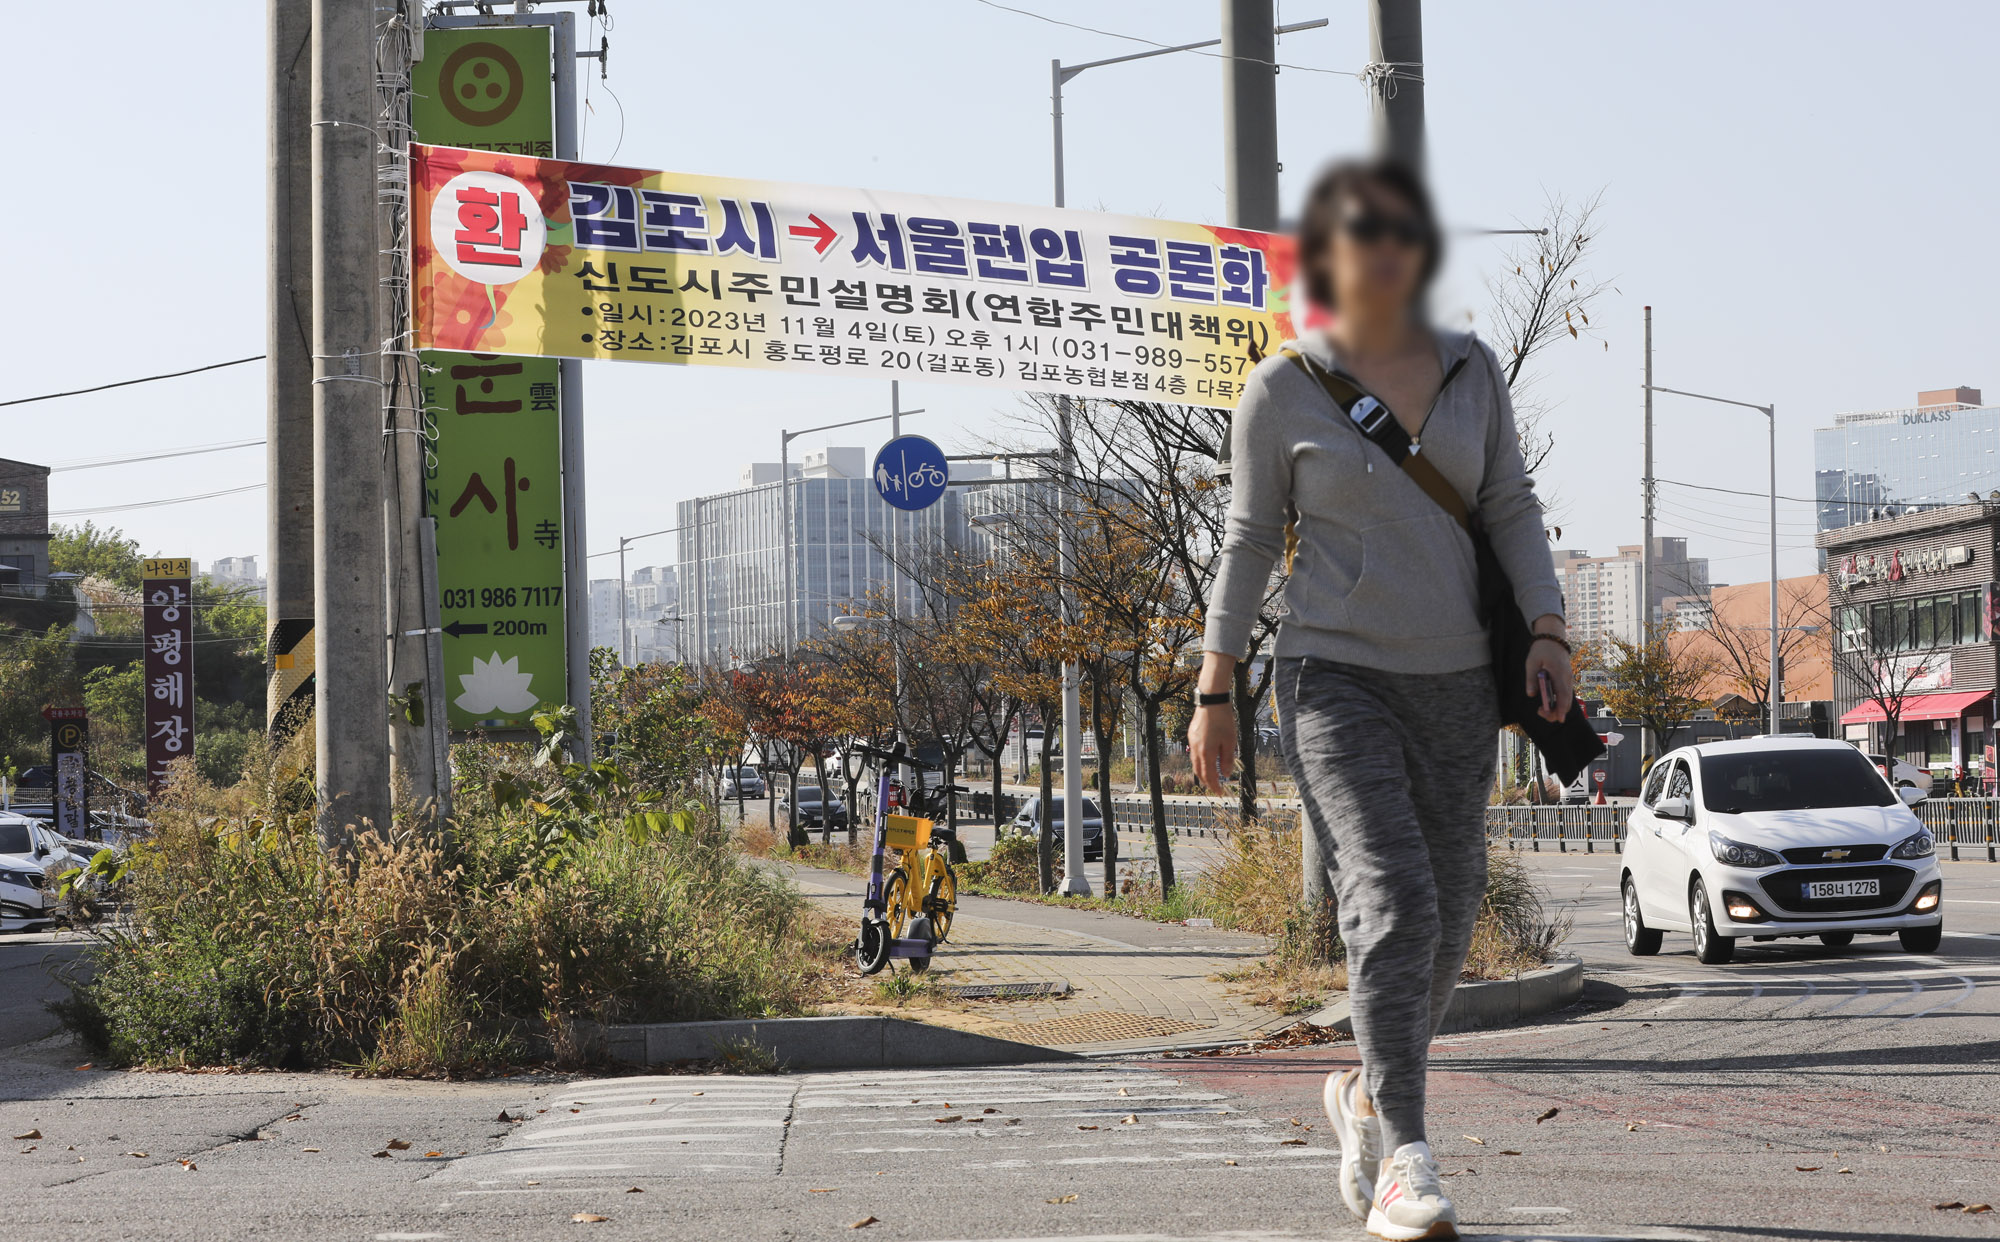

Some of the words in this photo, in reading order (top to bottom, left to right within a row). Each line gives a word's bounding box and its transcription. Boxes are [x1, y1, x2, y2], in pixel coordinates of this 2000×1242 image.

[454, 186, 528, 267] 환
[568, 182, 780, 261] 김포시
[851, 210, 1090, 291] 서울편입
[1108, 233, 1270, 311] 공론화
[599, 329, 750, 359] 장소:김포시
[764, 340, 869, 366] 홍도평로
[880, 350, 1005, 378] 20(걸포동)
[780, 315, 836, 338] 11월
[847, 321, 935, 346] 4일(토)
[945, 329, 992, 350] 오후
[1003, 334, 1039, 356] 1시
[1052, 335, 1253, 376] (031-989-557
[1903, 410, 1951, 425] DUKLASS
[146, 560, 189, 577] 나인식
[481, 587, 517, 608] 986
[521, 586, 562, 607] 7117
[493, 620, 548, 636] 200m
[1811, 884, 1844, 897] 158너
[1848, 881, 1877, 895] 1278
